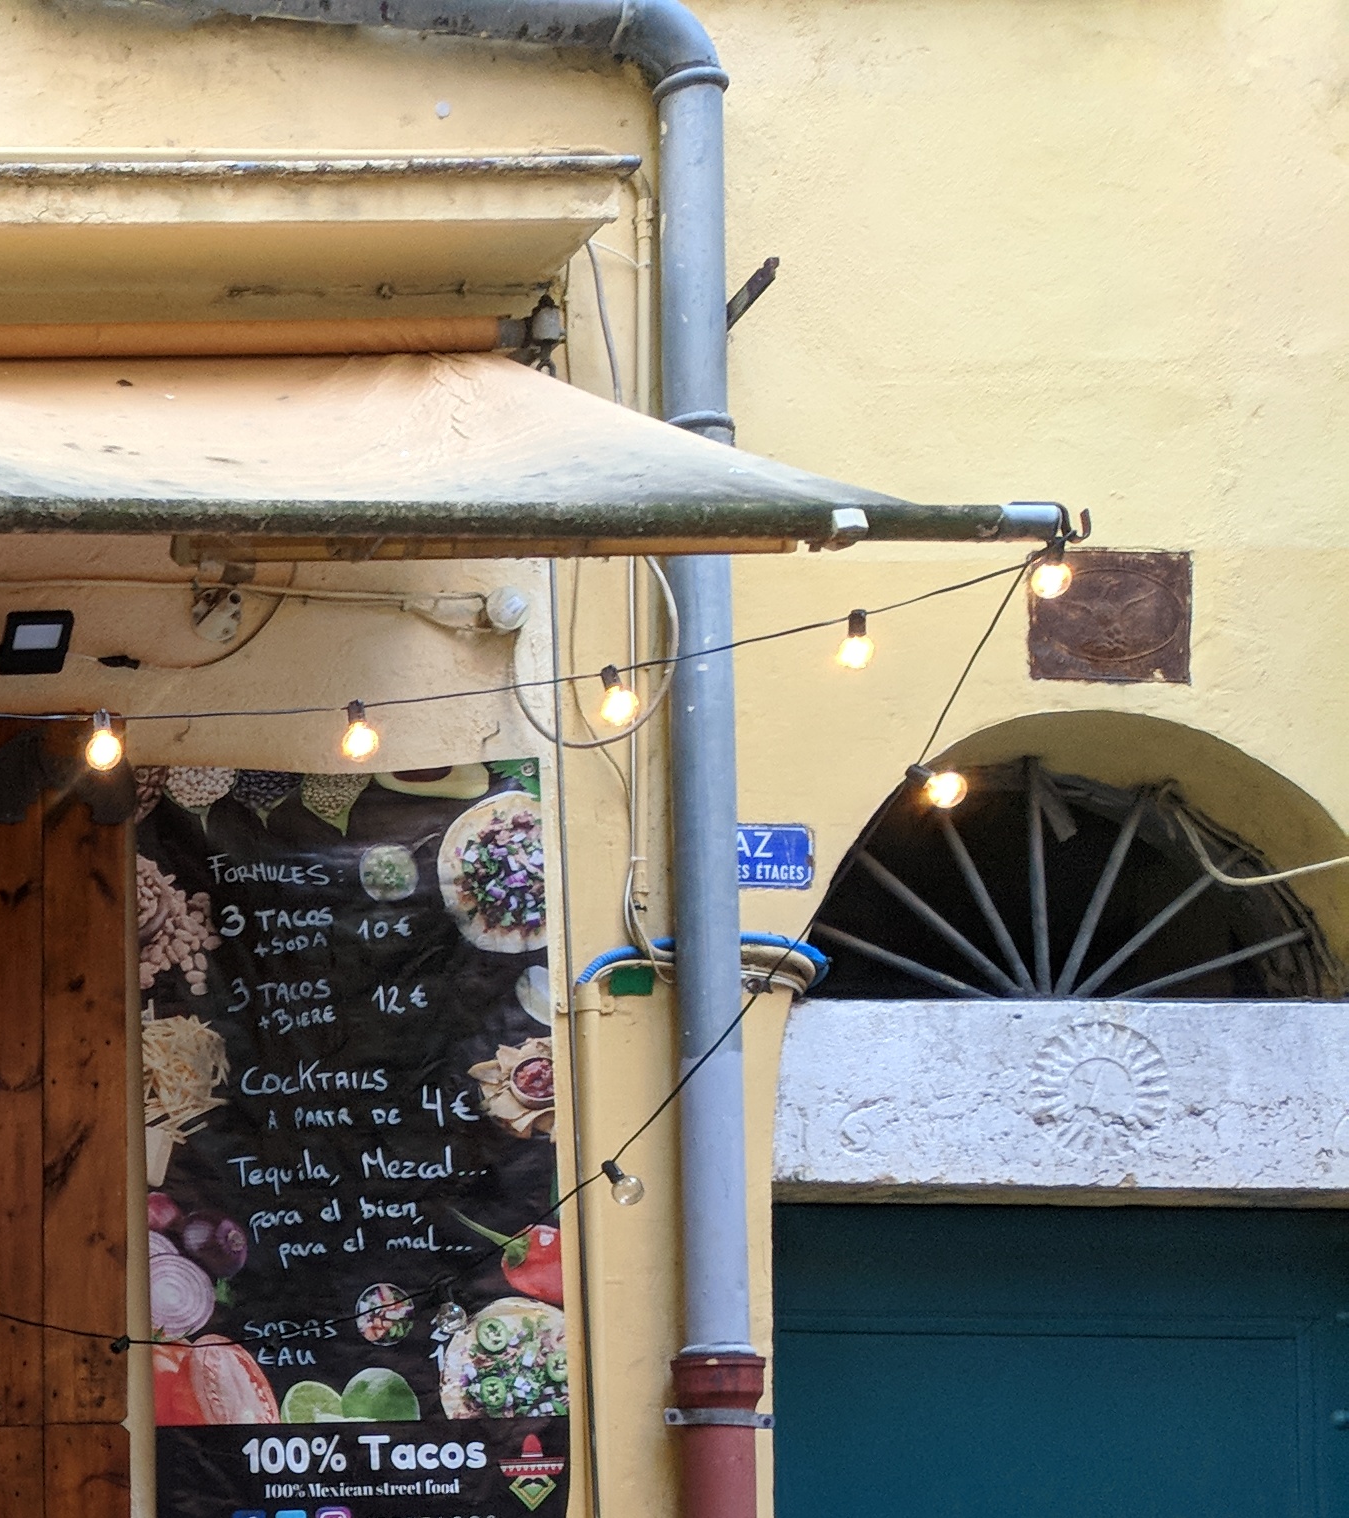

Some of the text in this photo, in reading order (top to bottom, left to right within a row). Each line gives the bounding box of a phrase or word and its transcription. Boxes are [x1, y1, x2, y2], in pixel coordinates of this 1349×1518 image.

[736, 831, 774, 859] AZ
[737, 862, 805, 880] ES ÉTAGES
[219, 904, 246, 937] 3
[254, 906, 334, 932] TACOS
[227, 976, 251, 1012] 3
[256, 978, 331, 1008] TACOS
[248, 1196, 425, 1245] para el bien,
[278, 1241, 328, 1270] para
[342, 1226, 366, 1253] el
[257, 1346, 317, 1366] EAU
[241, 1434, 488, 1474] 100% Tacos
[263, 1478, 461, 1499] 100% Mexican street food
